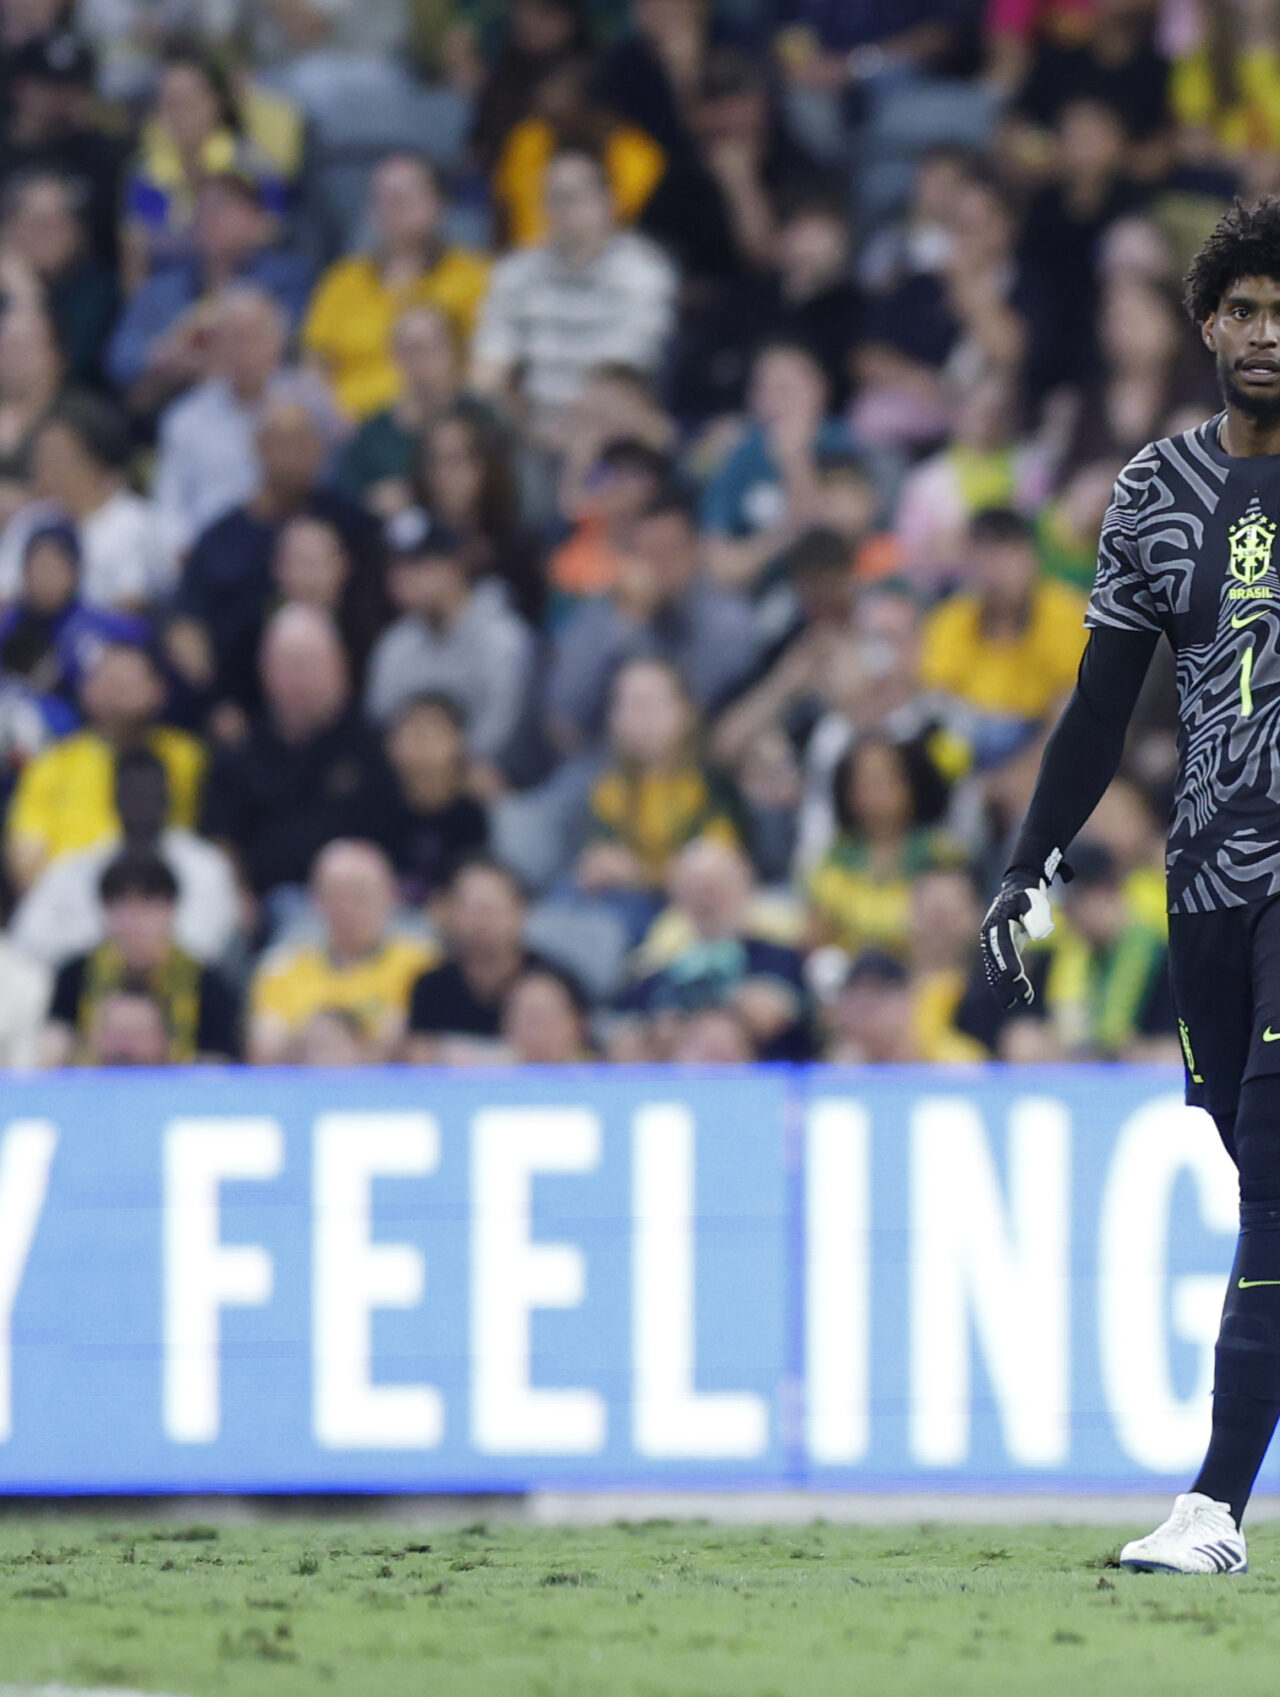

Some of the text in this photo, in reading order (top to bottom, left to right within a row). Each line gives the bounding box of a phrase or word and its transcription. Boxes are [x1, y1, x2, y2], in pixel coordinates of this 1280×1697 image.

[1229, 586, 1274, 600] BRASIL
[1240, 647, 1254, 717] 1
[163, 1093, 1241, 1472] FEELING
